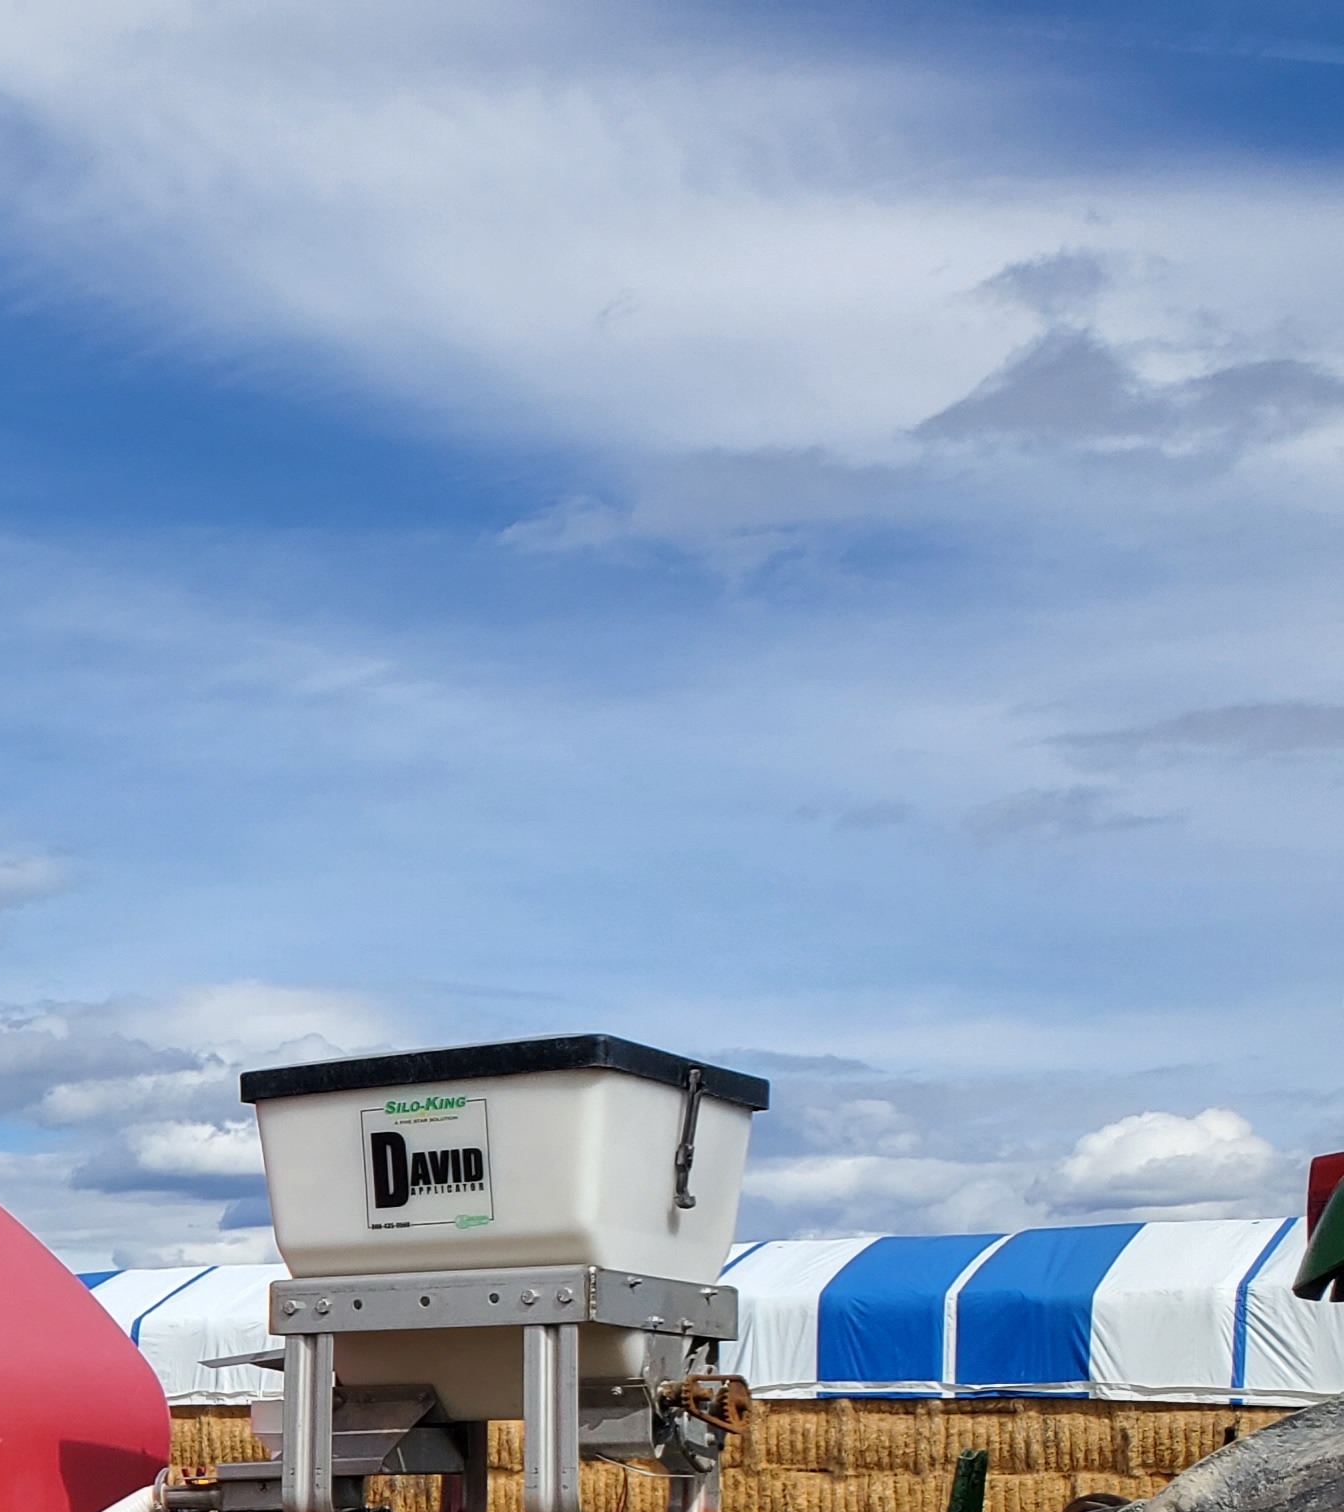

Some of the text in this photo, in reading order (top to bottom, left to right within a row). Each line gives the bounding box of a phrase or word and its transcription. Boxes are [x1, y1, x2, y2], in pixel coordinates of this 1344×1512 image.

[429, 1115, 459, 1123] SOLUTION
[370, 1131, 484, 1209] DAVID
[410, 1182, 485, 1196] APPLICATOR
